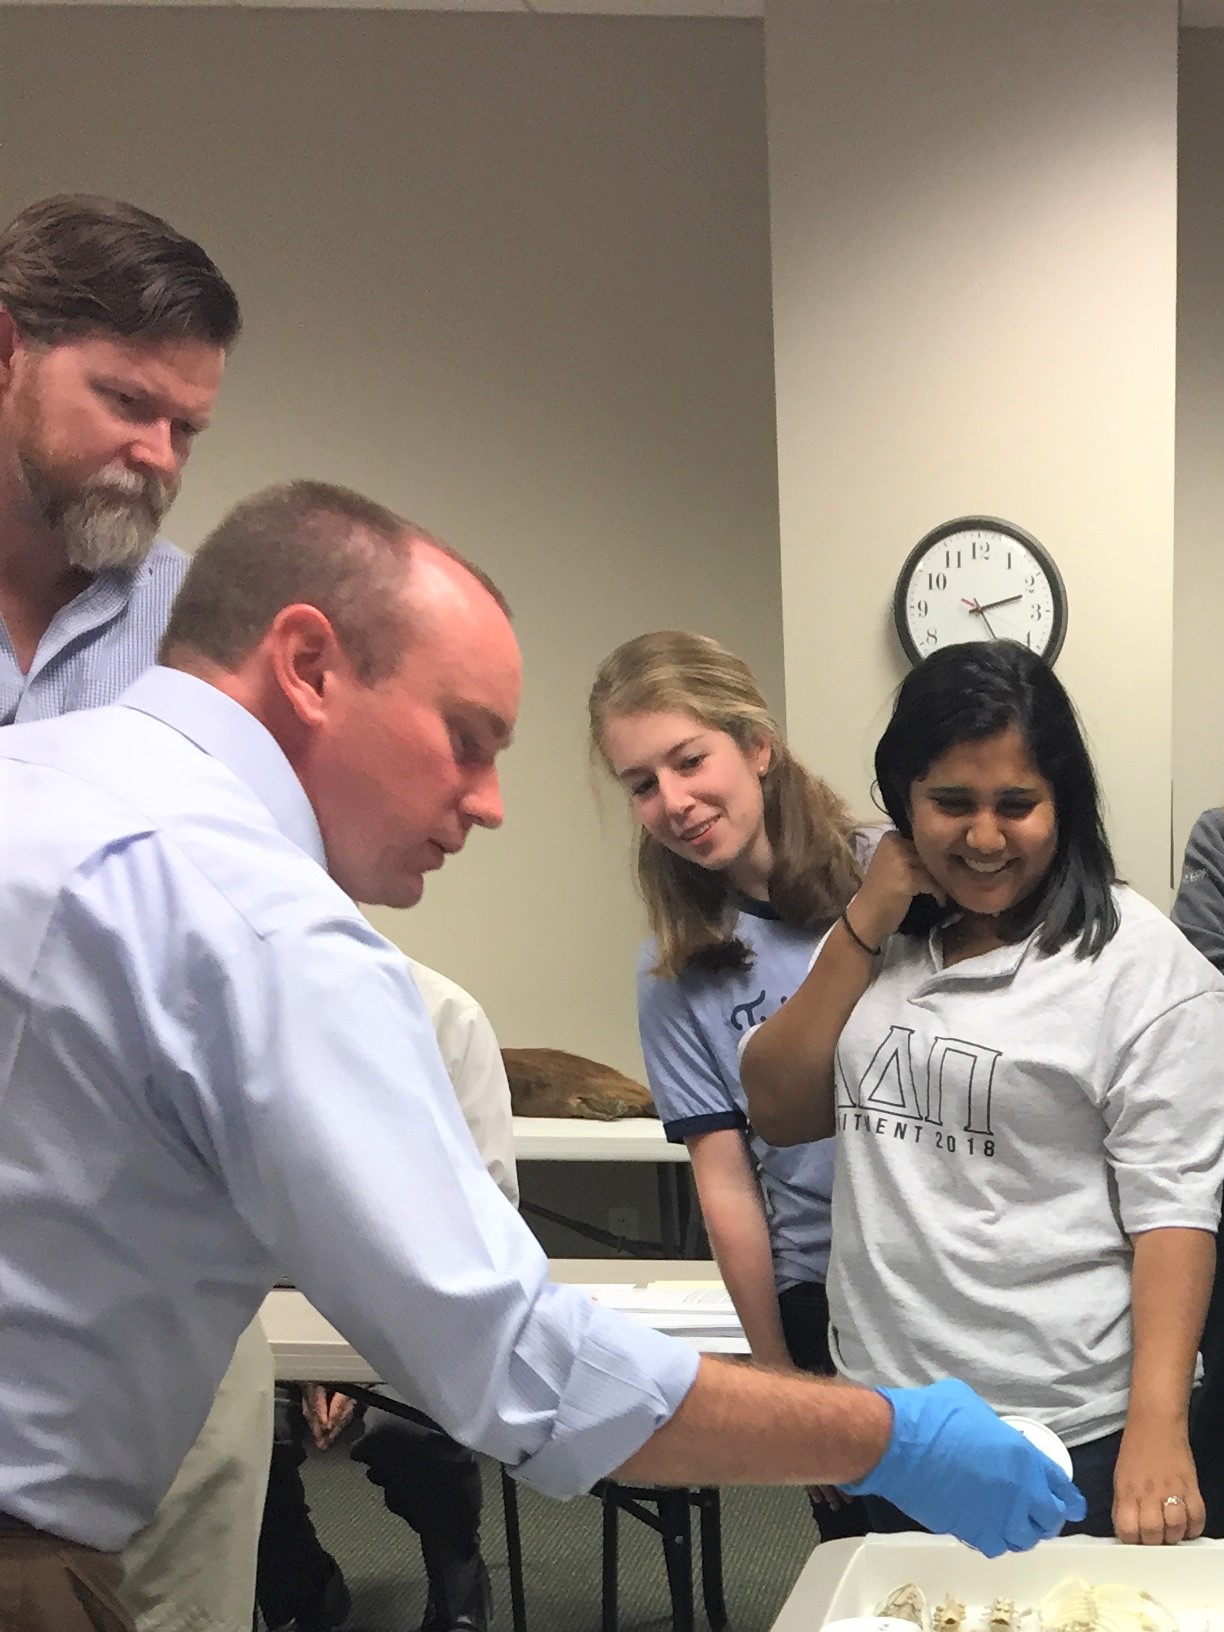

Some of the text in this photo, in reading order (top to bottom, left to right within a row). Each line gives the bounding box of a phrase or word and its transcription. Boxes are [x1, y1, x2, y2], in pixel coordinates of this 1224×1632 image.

[945, 550, 962, 569] 11
[971, 542, 990, 560] 12
[1006, 552, 1012, 570] 1
[927, 572, 947, 591] 10
[1024, 575, 1035, 593] 2
[917, 599, 928, 618] 9
[1030, 603, 1042, 622] 3
[925, 628, 938, 646] 8
[935, 1131, 996, 1157] 2018
